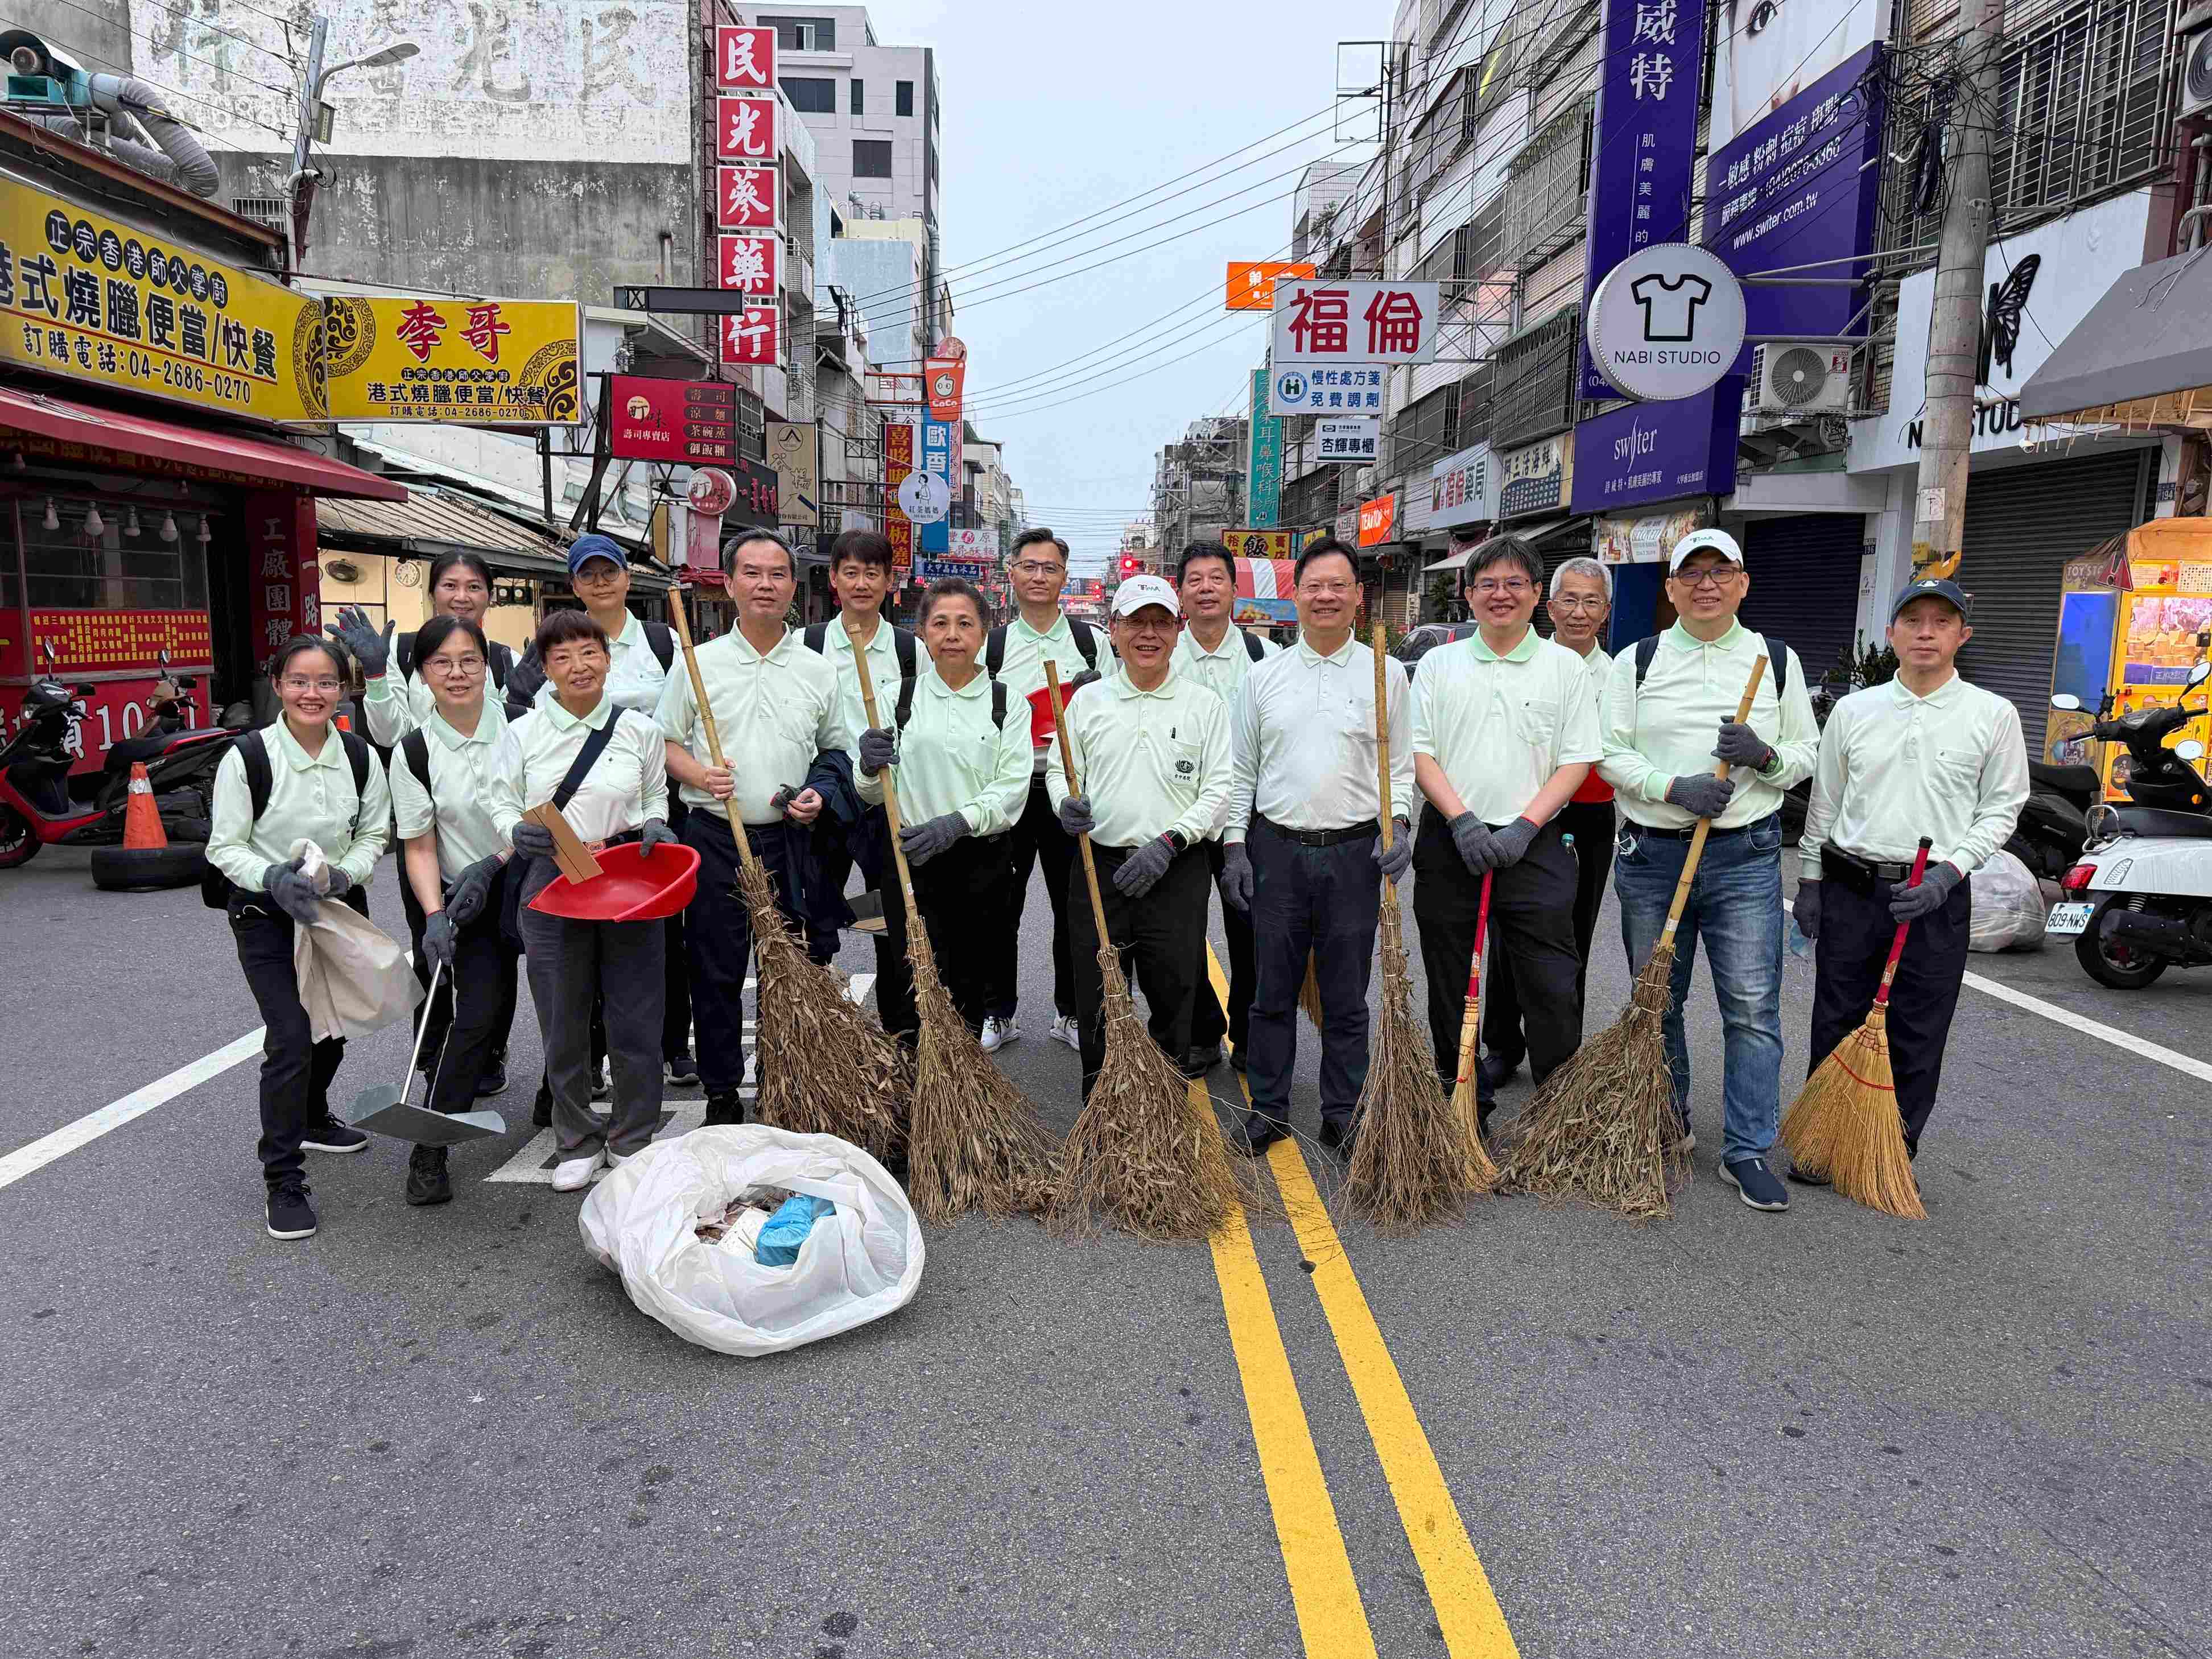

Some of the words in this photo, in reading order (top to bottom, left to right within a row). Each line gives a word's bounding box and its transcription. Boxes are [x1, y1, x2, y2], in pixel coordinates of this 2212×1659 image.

[1631, 0, 1676, 101] 威特
[1635, 133, 1656, 244] 肌膚美麗的
[397, 300, 511, 363] 李哥
[1288, 288, 1423, 353] 福倫
[1614, 351, 1652, 364] NABI
[1658, 350, 1720, 364] STUDIO
[1311, 370, 1380, 386] 慢性處方箋
[1310, 391, 1380, 407] 免費調劑
[1322, 438, 1375, 453] 杏輝專櫃
